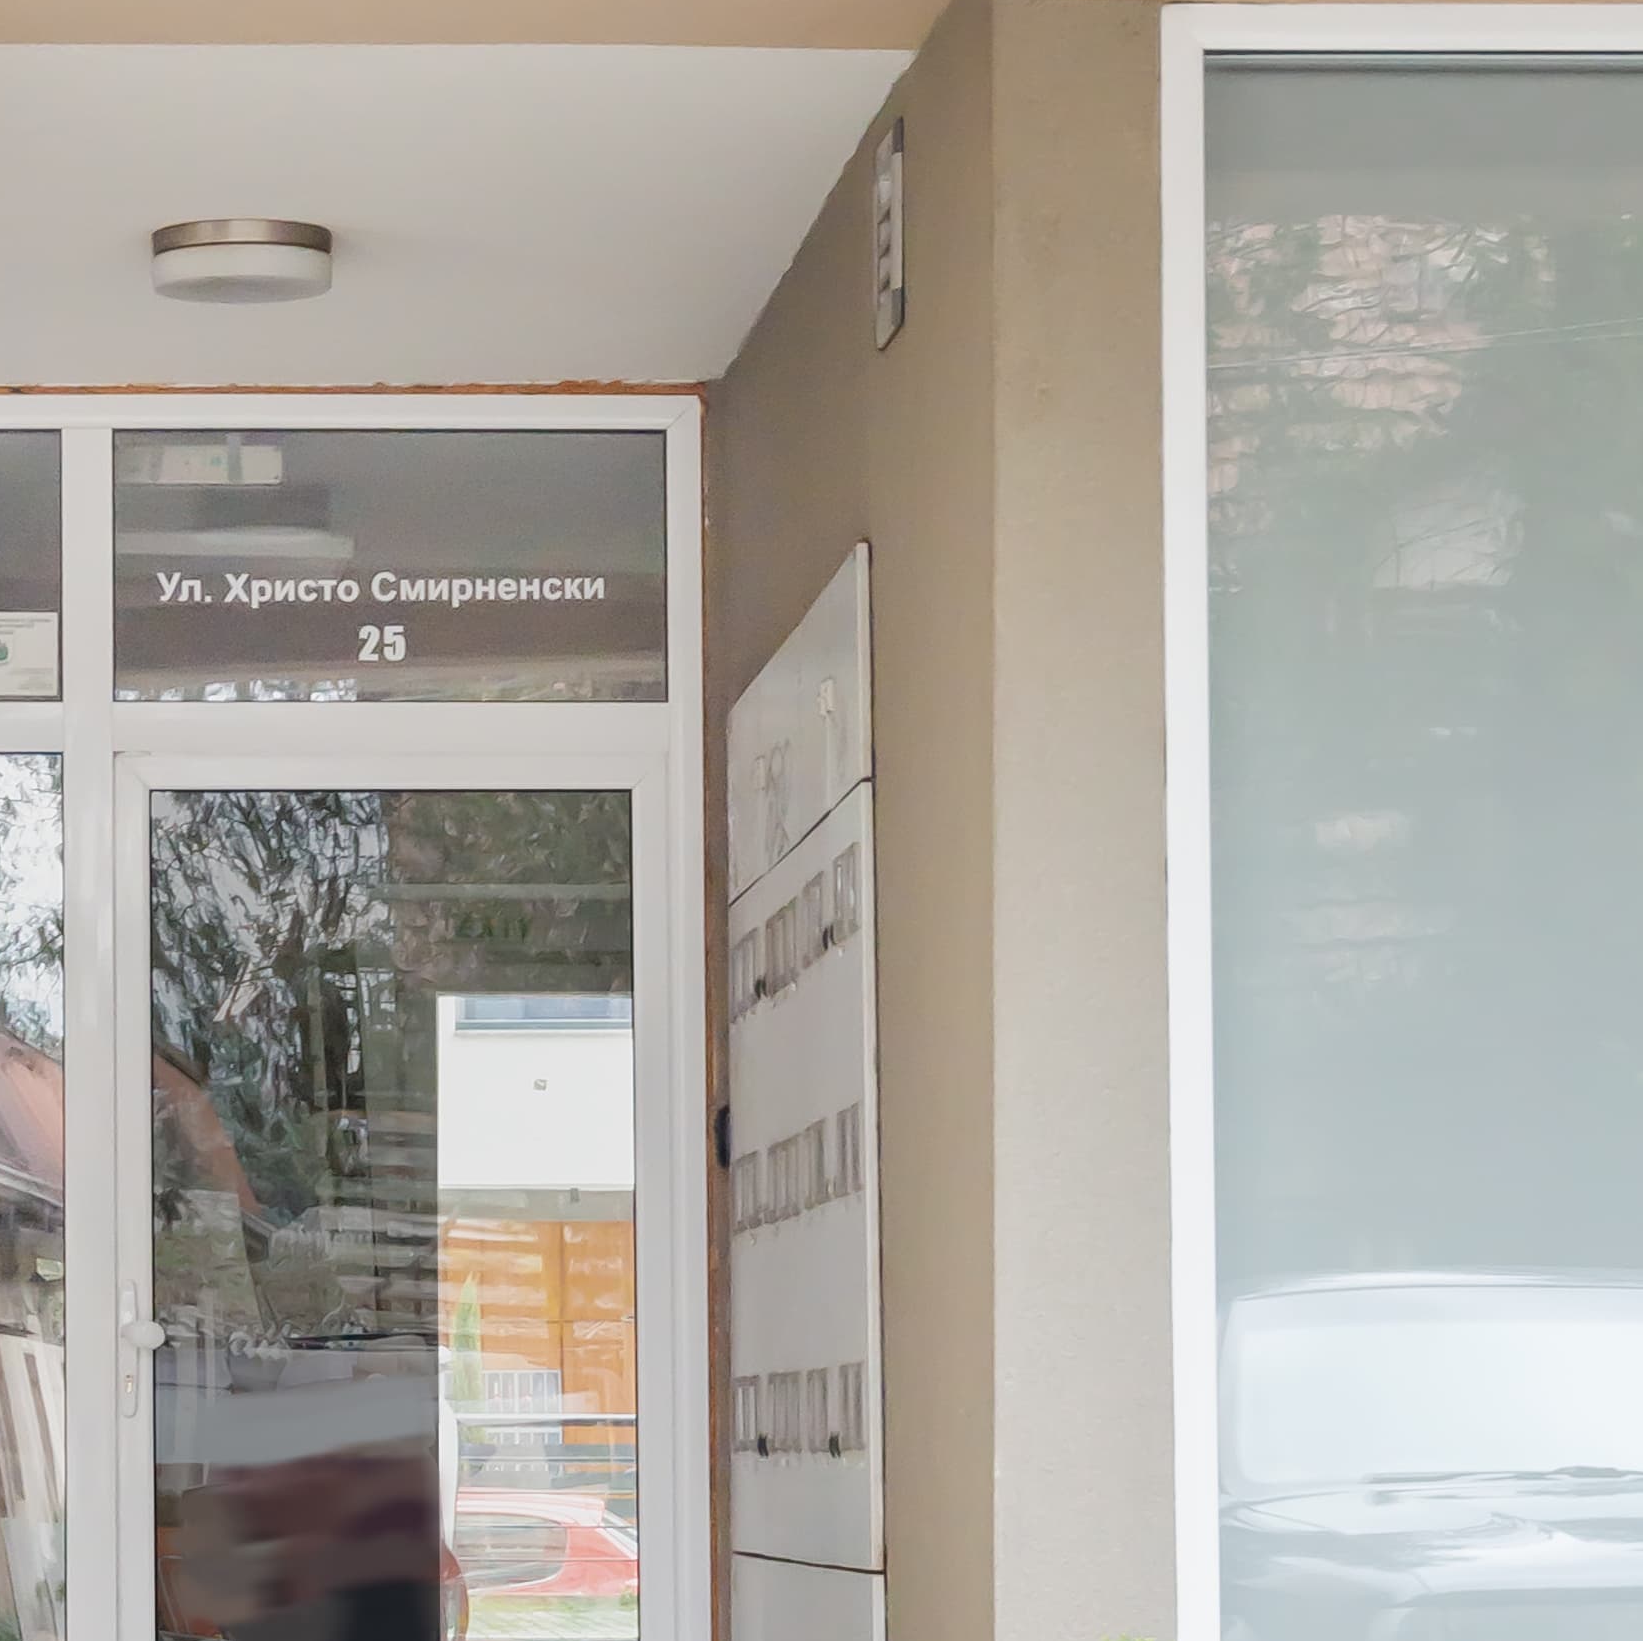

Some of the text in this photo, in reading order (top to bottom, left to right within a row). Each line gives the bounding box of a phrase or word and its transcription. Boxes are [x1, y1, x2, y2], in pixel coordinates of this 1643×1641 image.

[157, 572, 606, 609] Ул. Христо Смирненски
[357, 625, 407, 662] 25
